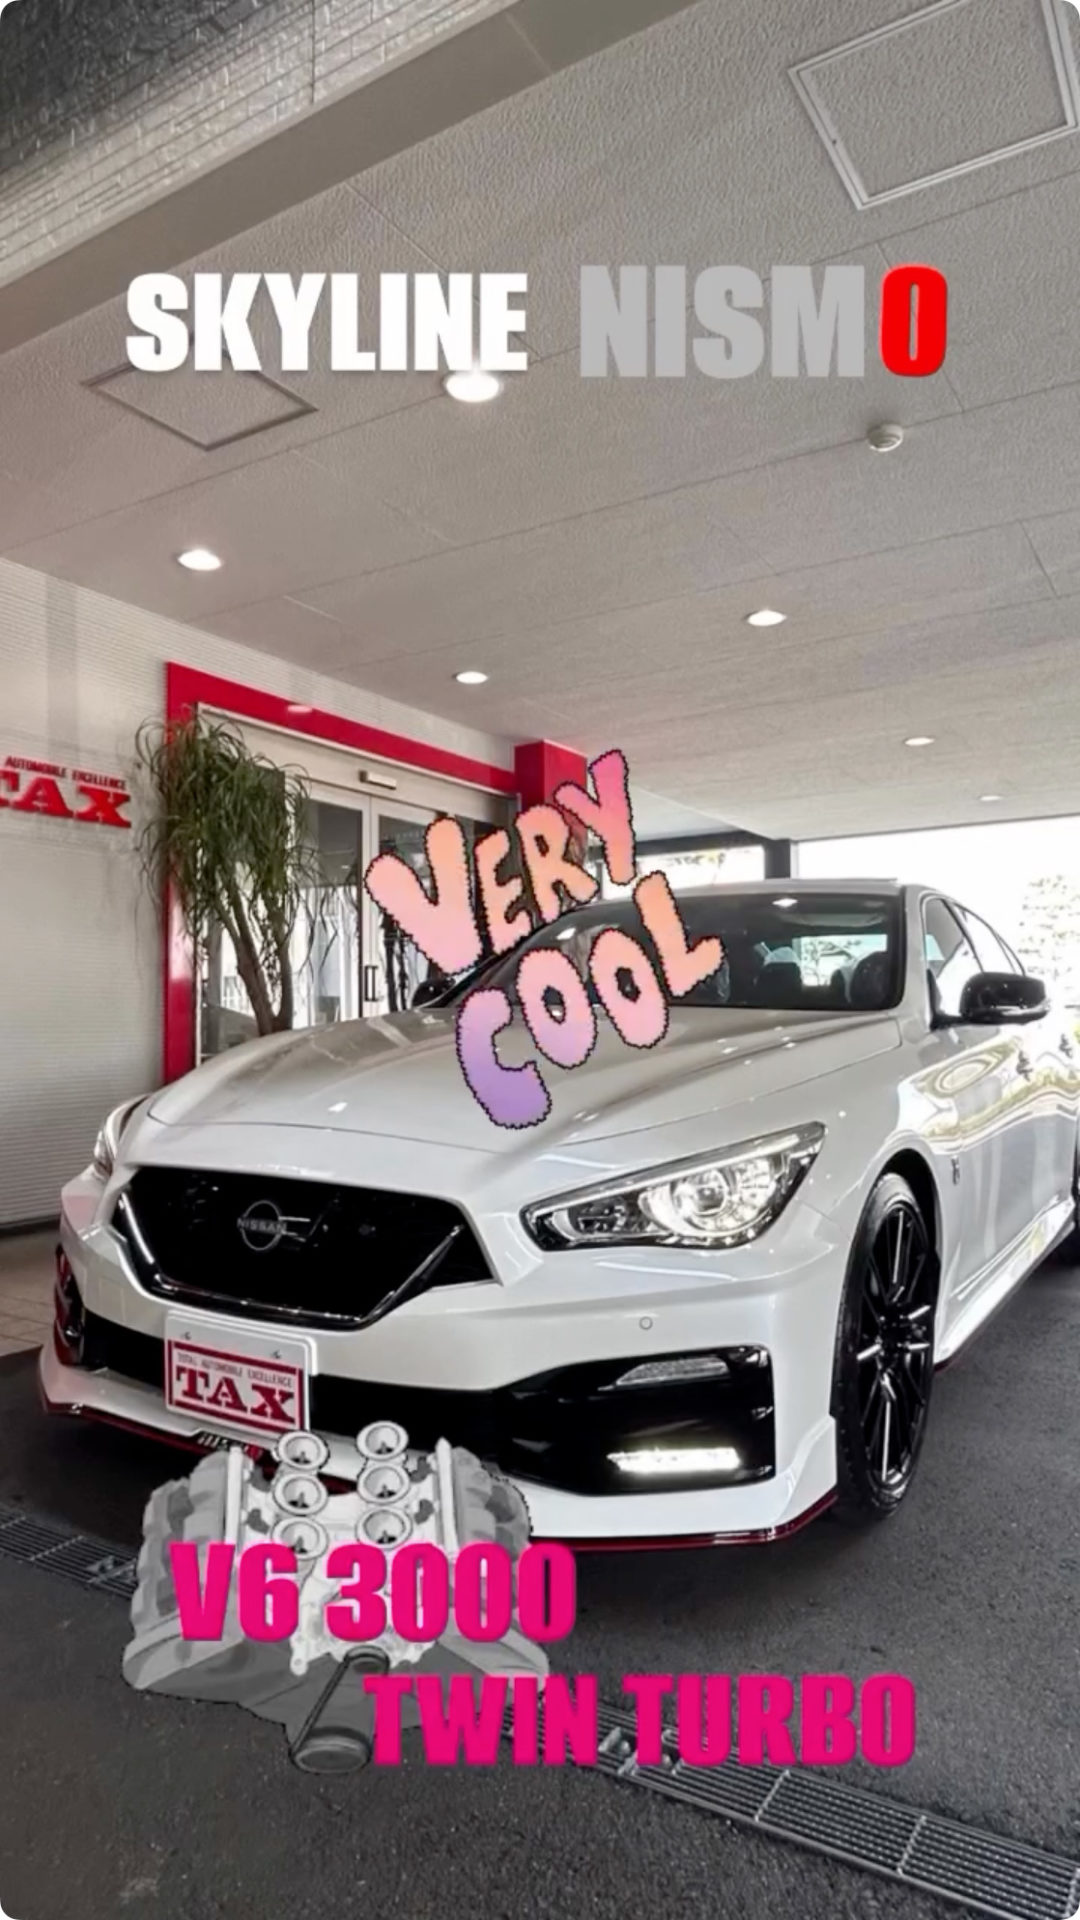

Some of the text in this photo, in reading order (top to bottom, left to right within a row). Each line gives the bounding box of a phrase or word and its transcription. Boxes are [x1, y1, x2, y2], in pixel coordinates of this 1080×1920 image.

[5, 756, 126, 790] AUTOMOBILE EXCELLENCE
[237, 1217, 287, 1234] NISSAN
[175, 1365, 295, 1423] TAX
